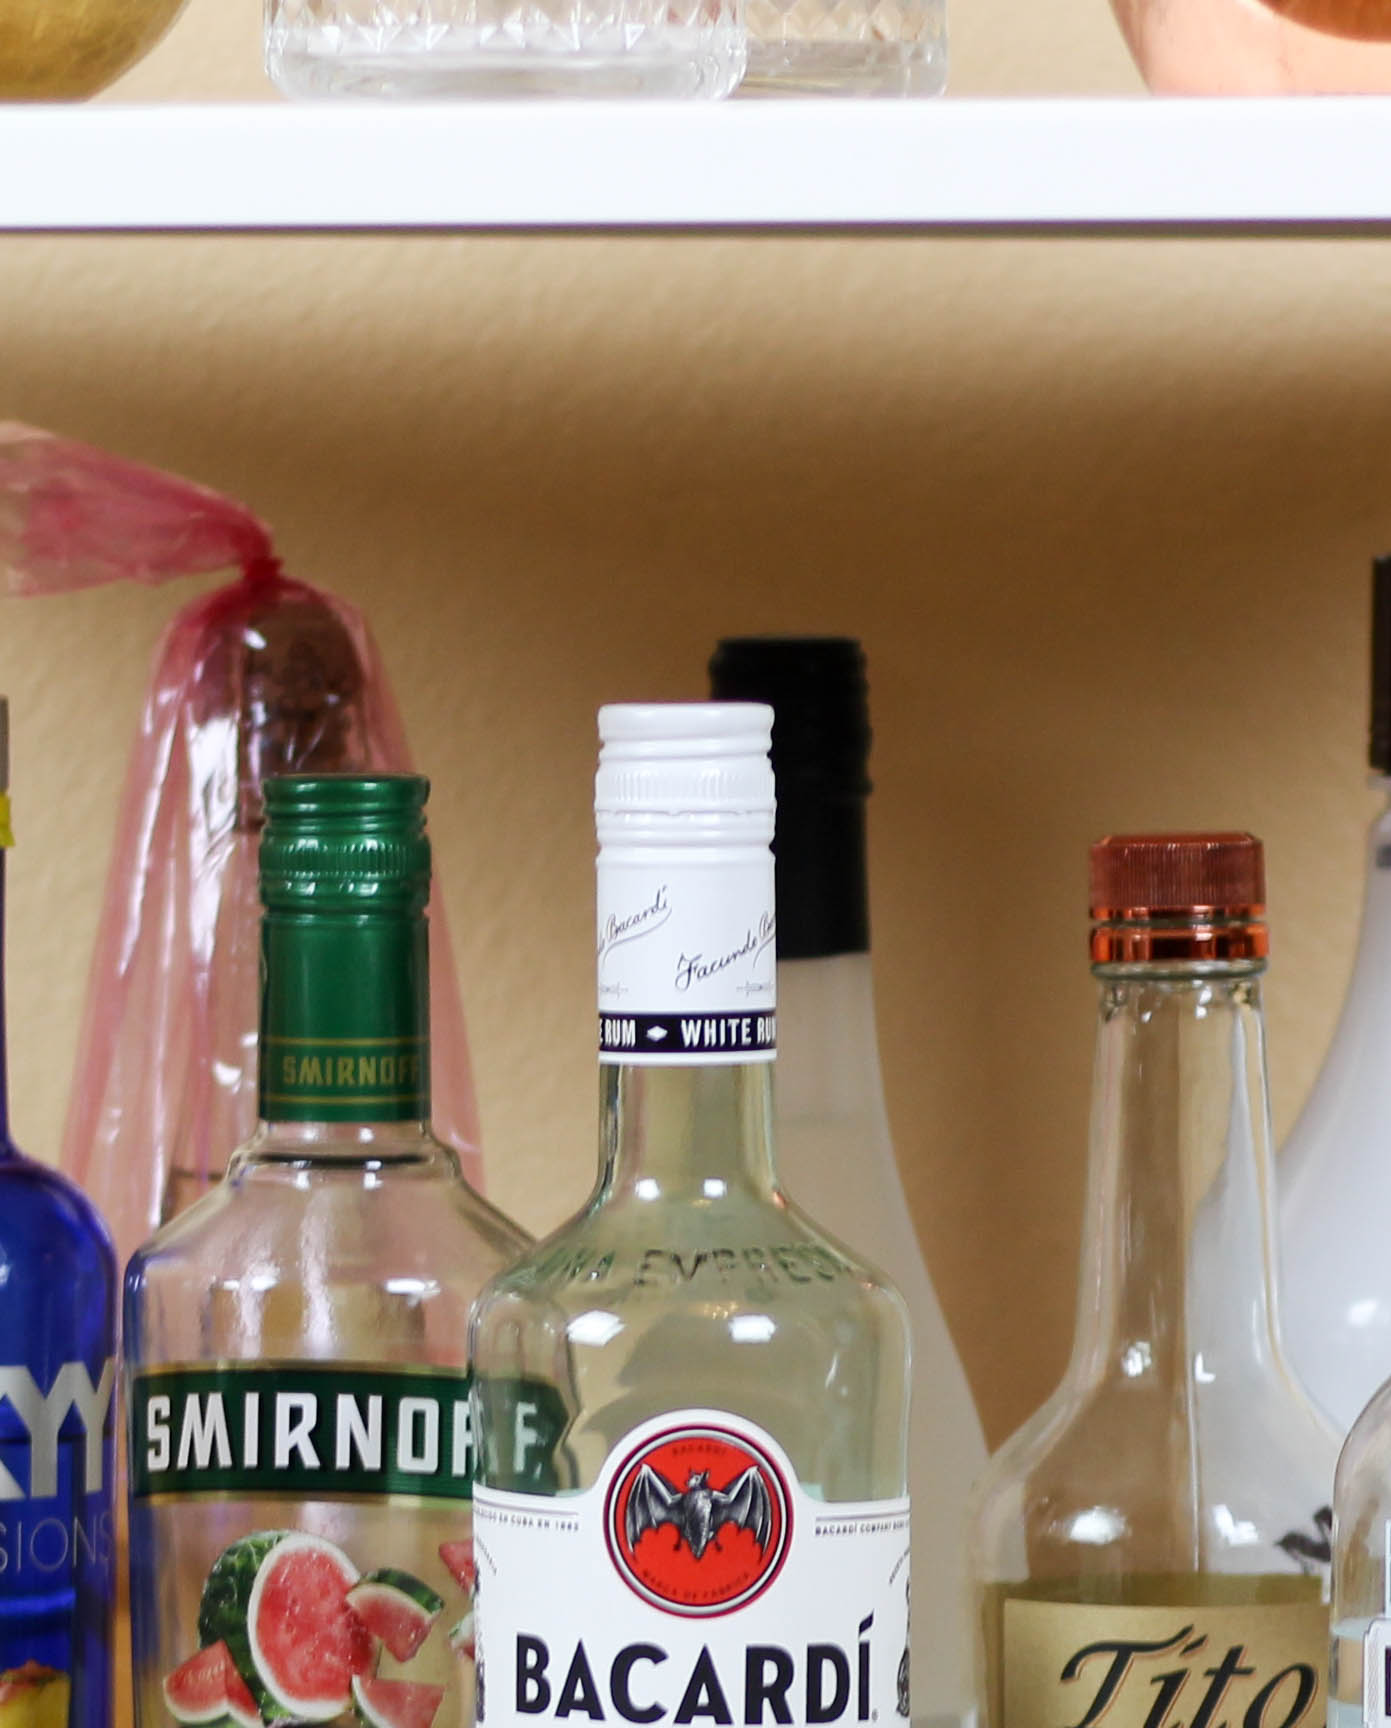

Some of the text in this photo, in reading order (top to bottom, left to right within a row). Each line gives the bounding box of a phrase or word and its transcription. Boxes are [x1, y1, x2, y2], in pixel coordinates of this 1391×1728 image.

[604, 1018, 637, 1048] RUM
[680, 1017, 752, 1048] WHITE
[515, 1610, 876, 1726] BACARDÍ
